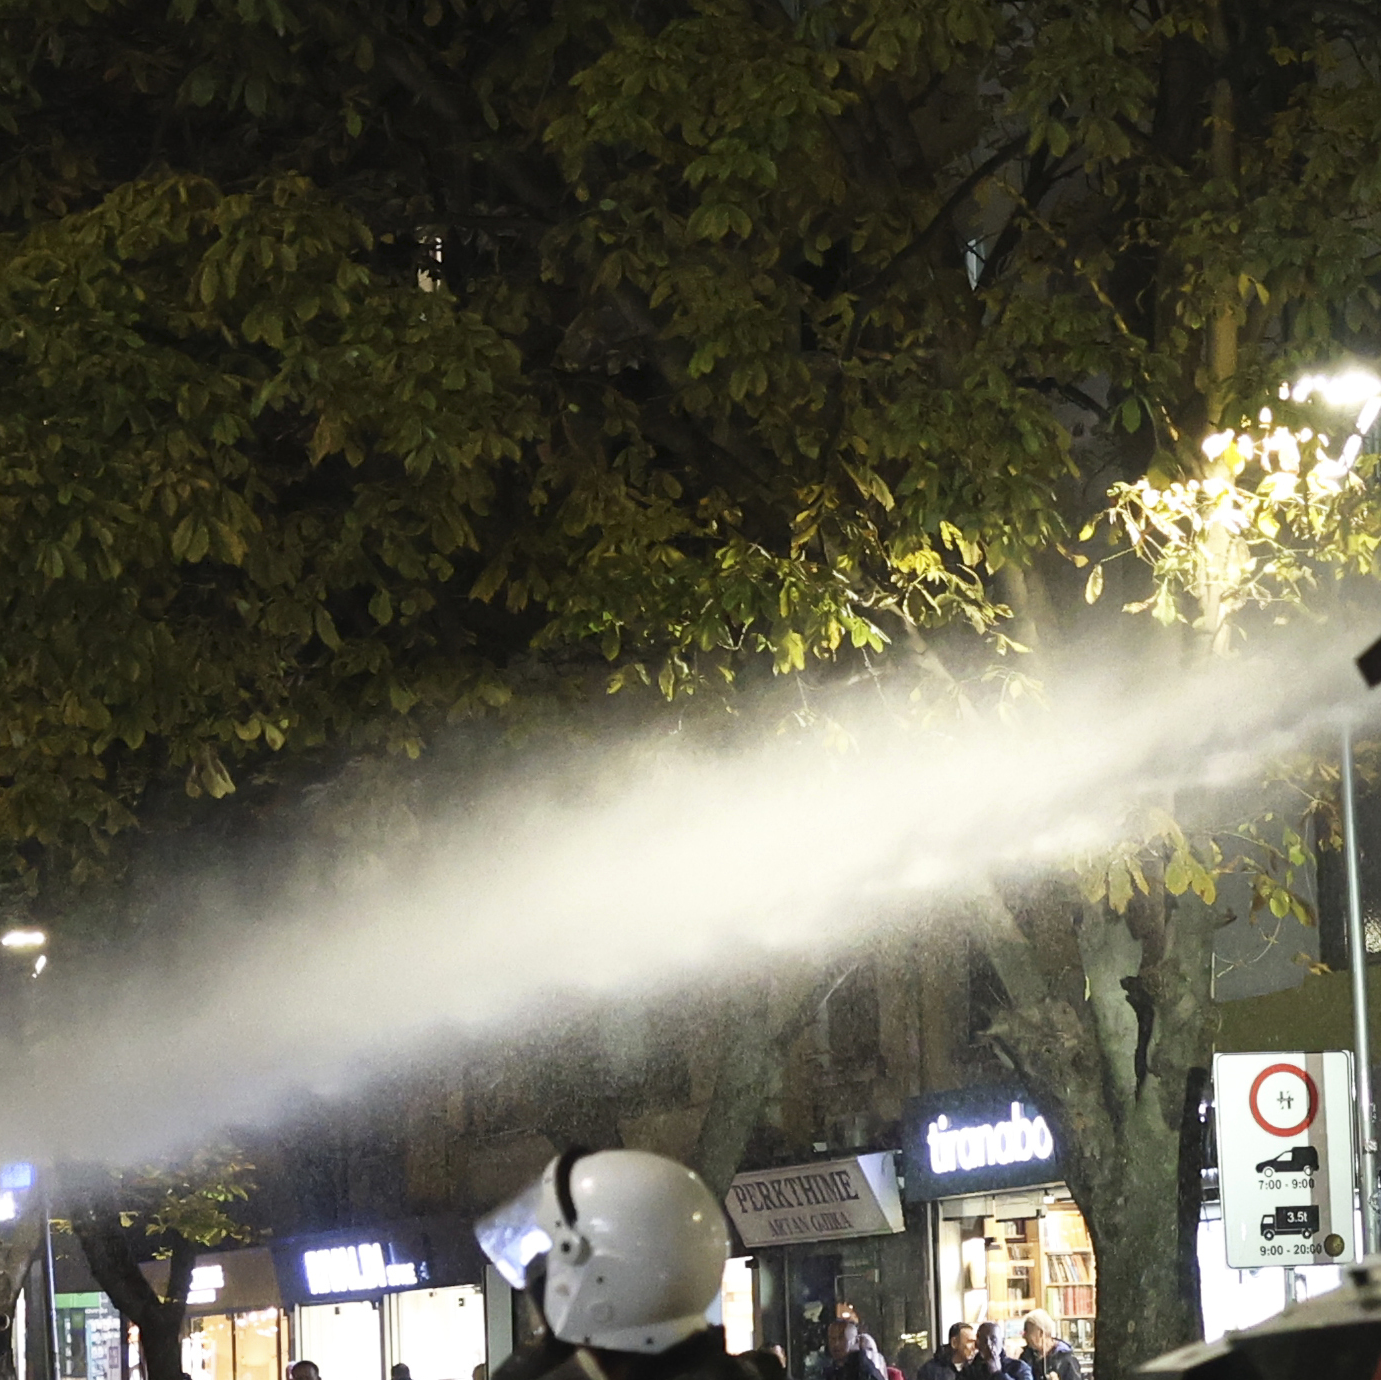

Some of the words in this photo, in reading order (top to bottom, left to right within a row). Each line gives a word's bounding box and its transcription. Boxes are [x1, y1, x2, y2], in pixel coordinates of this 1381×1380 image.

[1258, 1180, 1282, 1190] 7:00
[1291, 1178, 1315, 1189] 9:00
[731, 1170, 859, 1213] PERKTHIME
[1286, 1211, 1308, 1223] 3.5t
[1259, 1246, 1283, 1256] 9:00
[1293, 1244, 1323, 1255] 20:00
